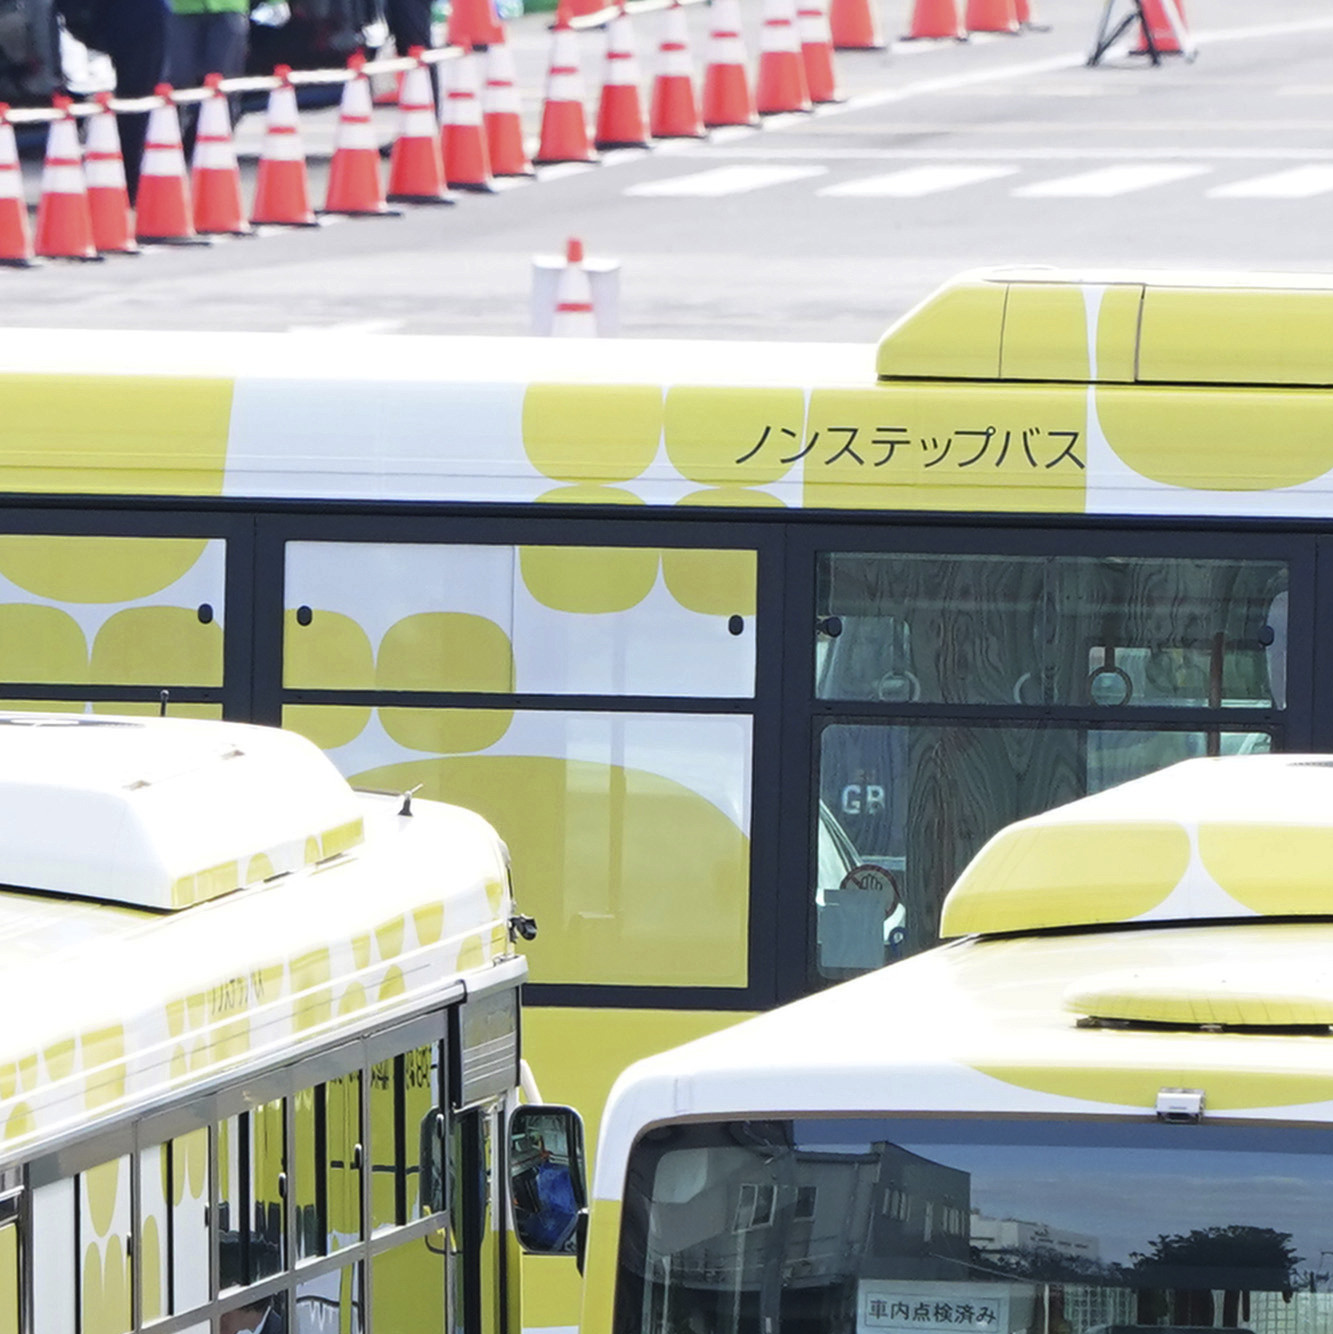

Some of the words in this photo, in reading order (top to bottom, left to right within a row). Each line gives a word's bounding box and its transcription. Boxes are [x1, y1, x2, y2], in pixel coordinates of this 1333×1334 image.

[734, 424, 1086, 470] ノンステップバス
[868, 1299, 997, 1325] 車内点検済み
